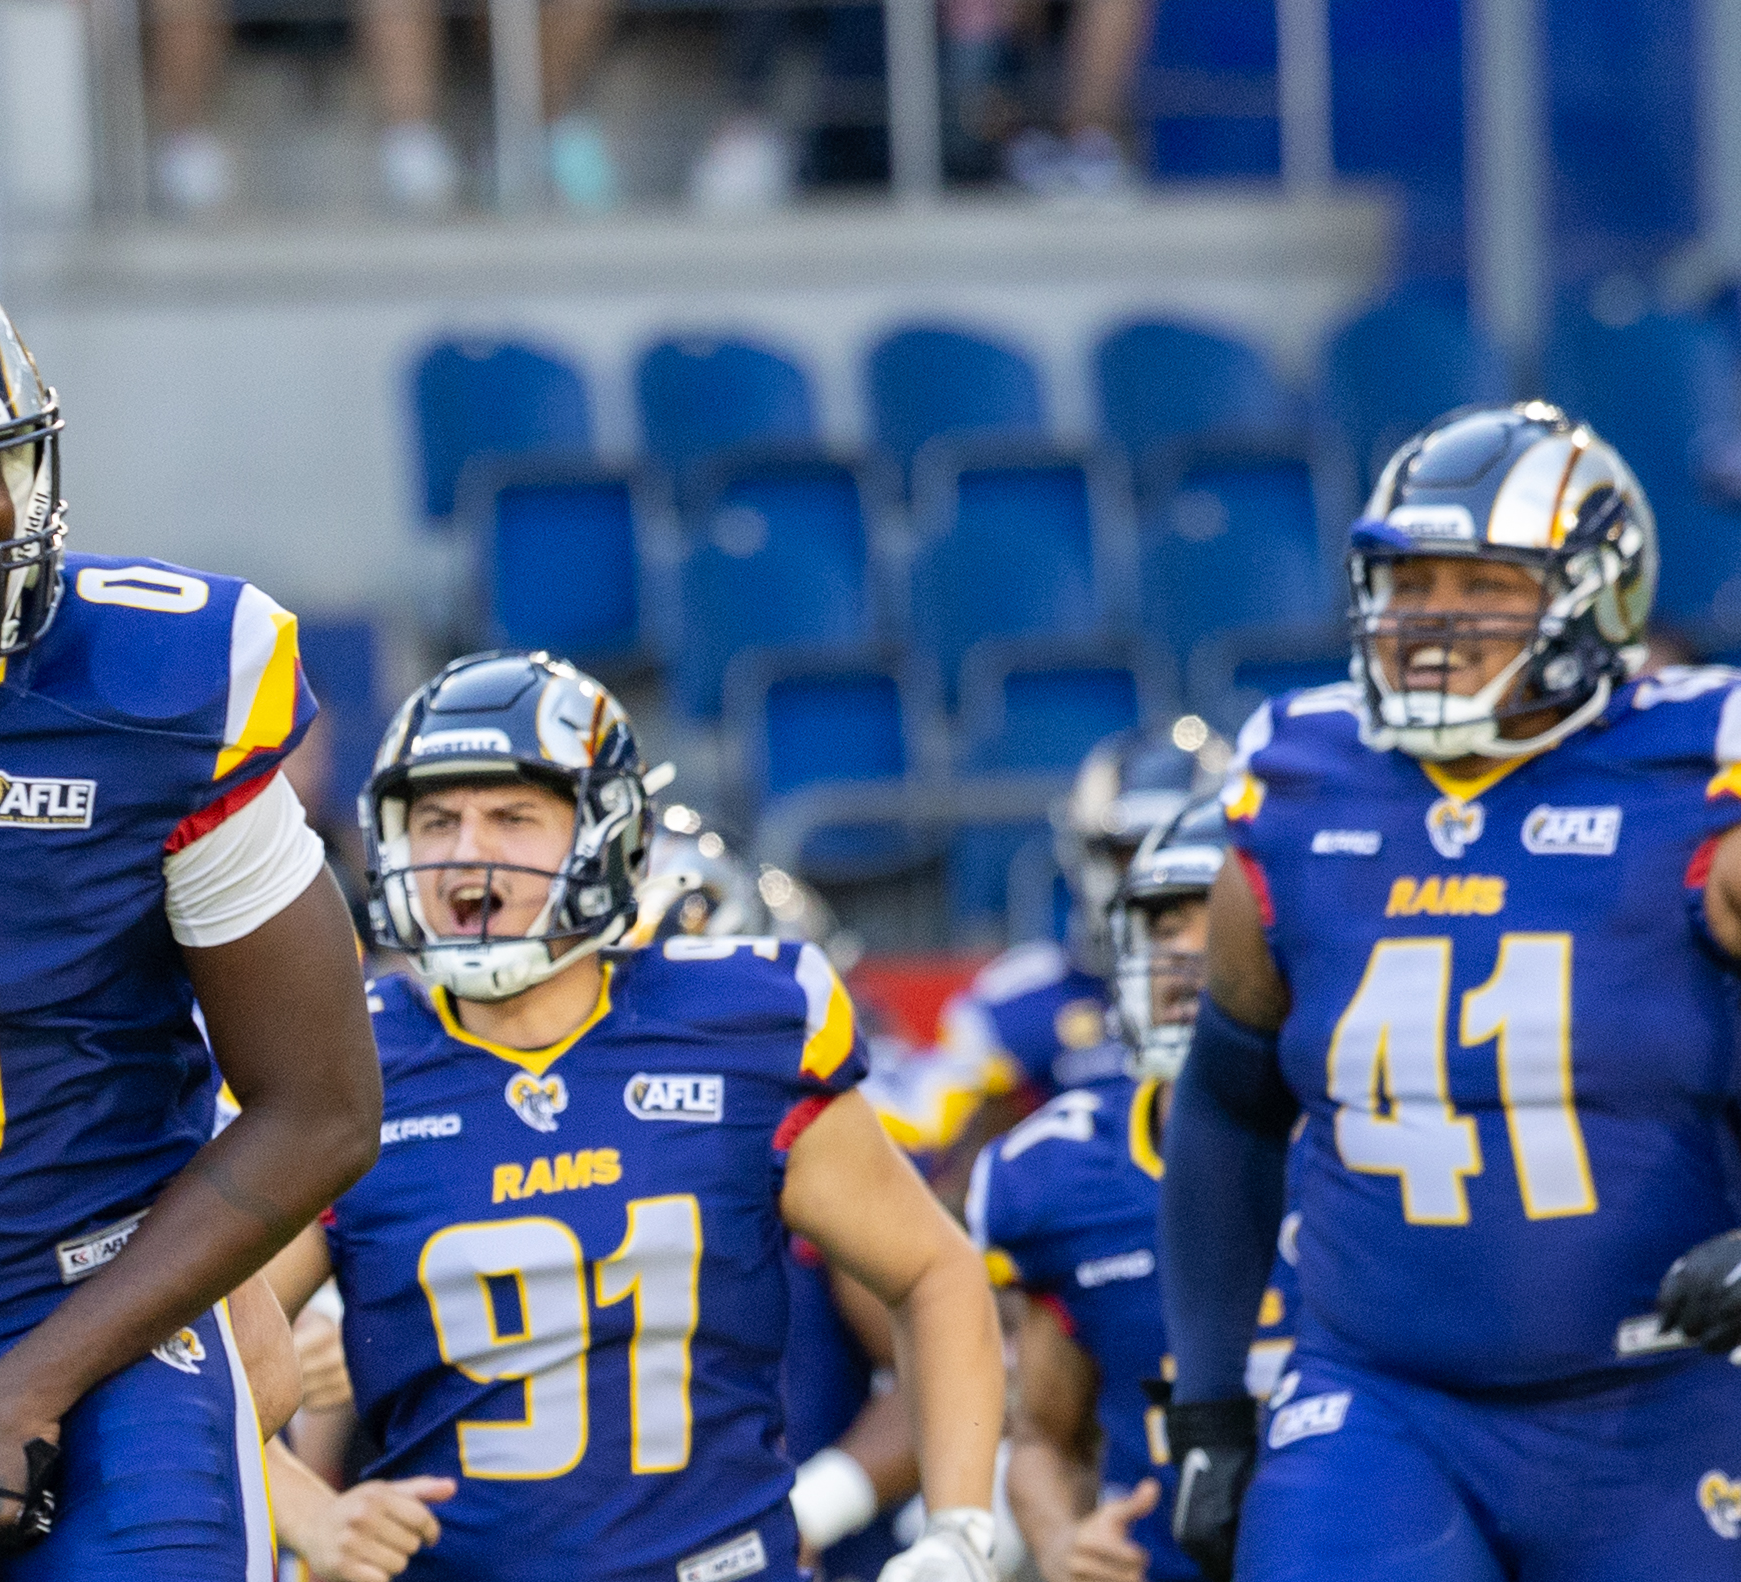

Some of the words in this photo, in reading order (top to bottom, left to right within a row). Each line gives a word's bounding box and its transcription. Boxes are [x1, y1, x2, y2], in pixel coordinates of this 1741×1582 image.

[76, 566, 209, 613] 0
[1385, 875, 1506, 918] RAMS
[642, 1082, 717, 1112] AFLE
[1326, 931, 1598, 1226] 41
[492, 1147, 622, 1204] RAMS
[417, 1193, 704, 1480] 91
